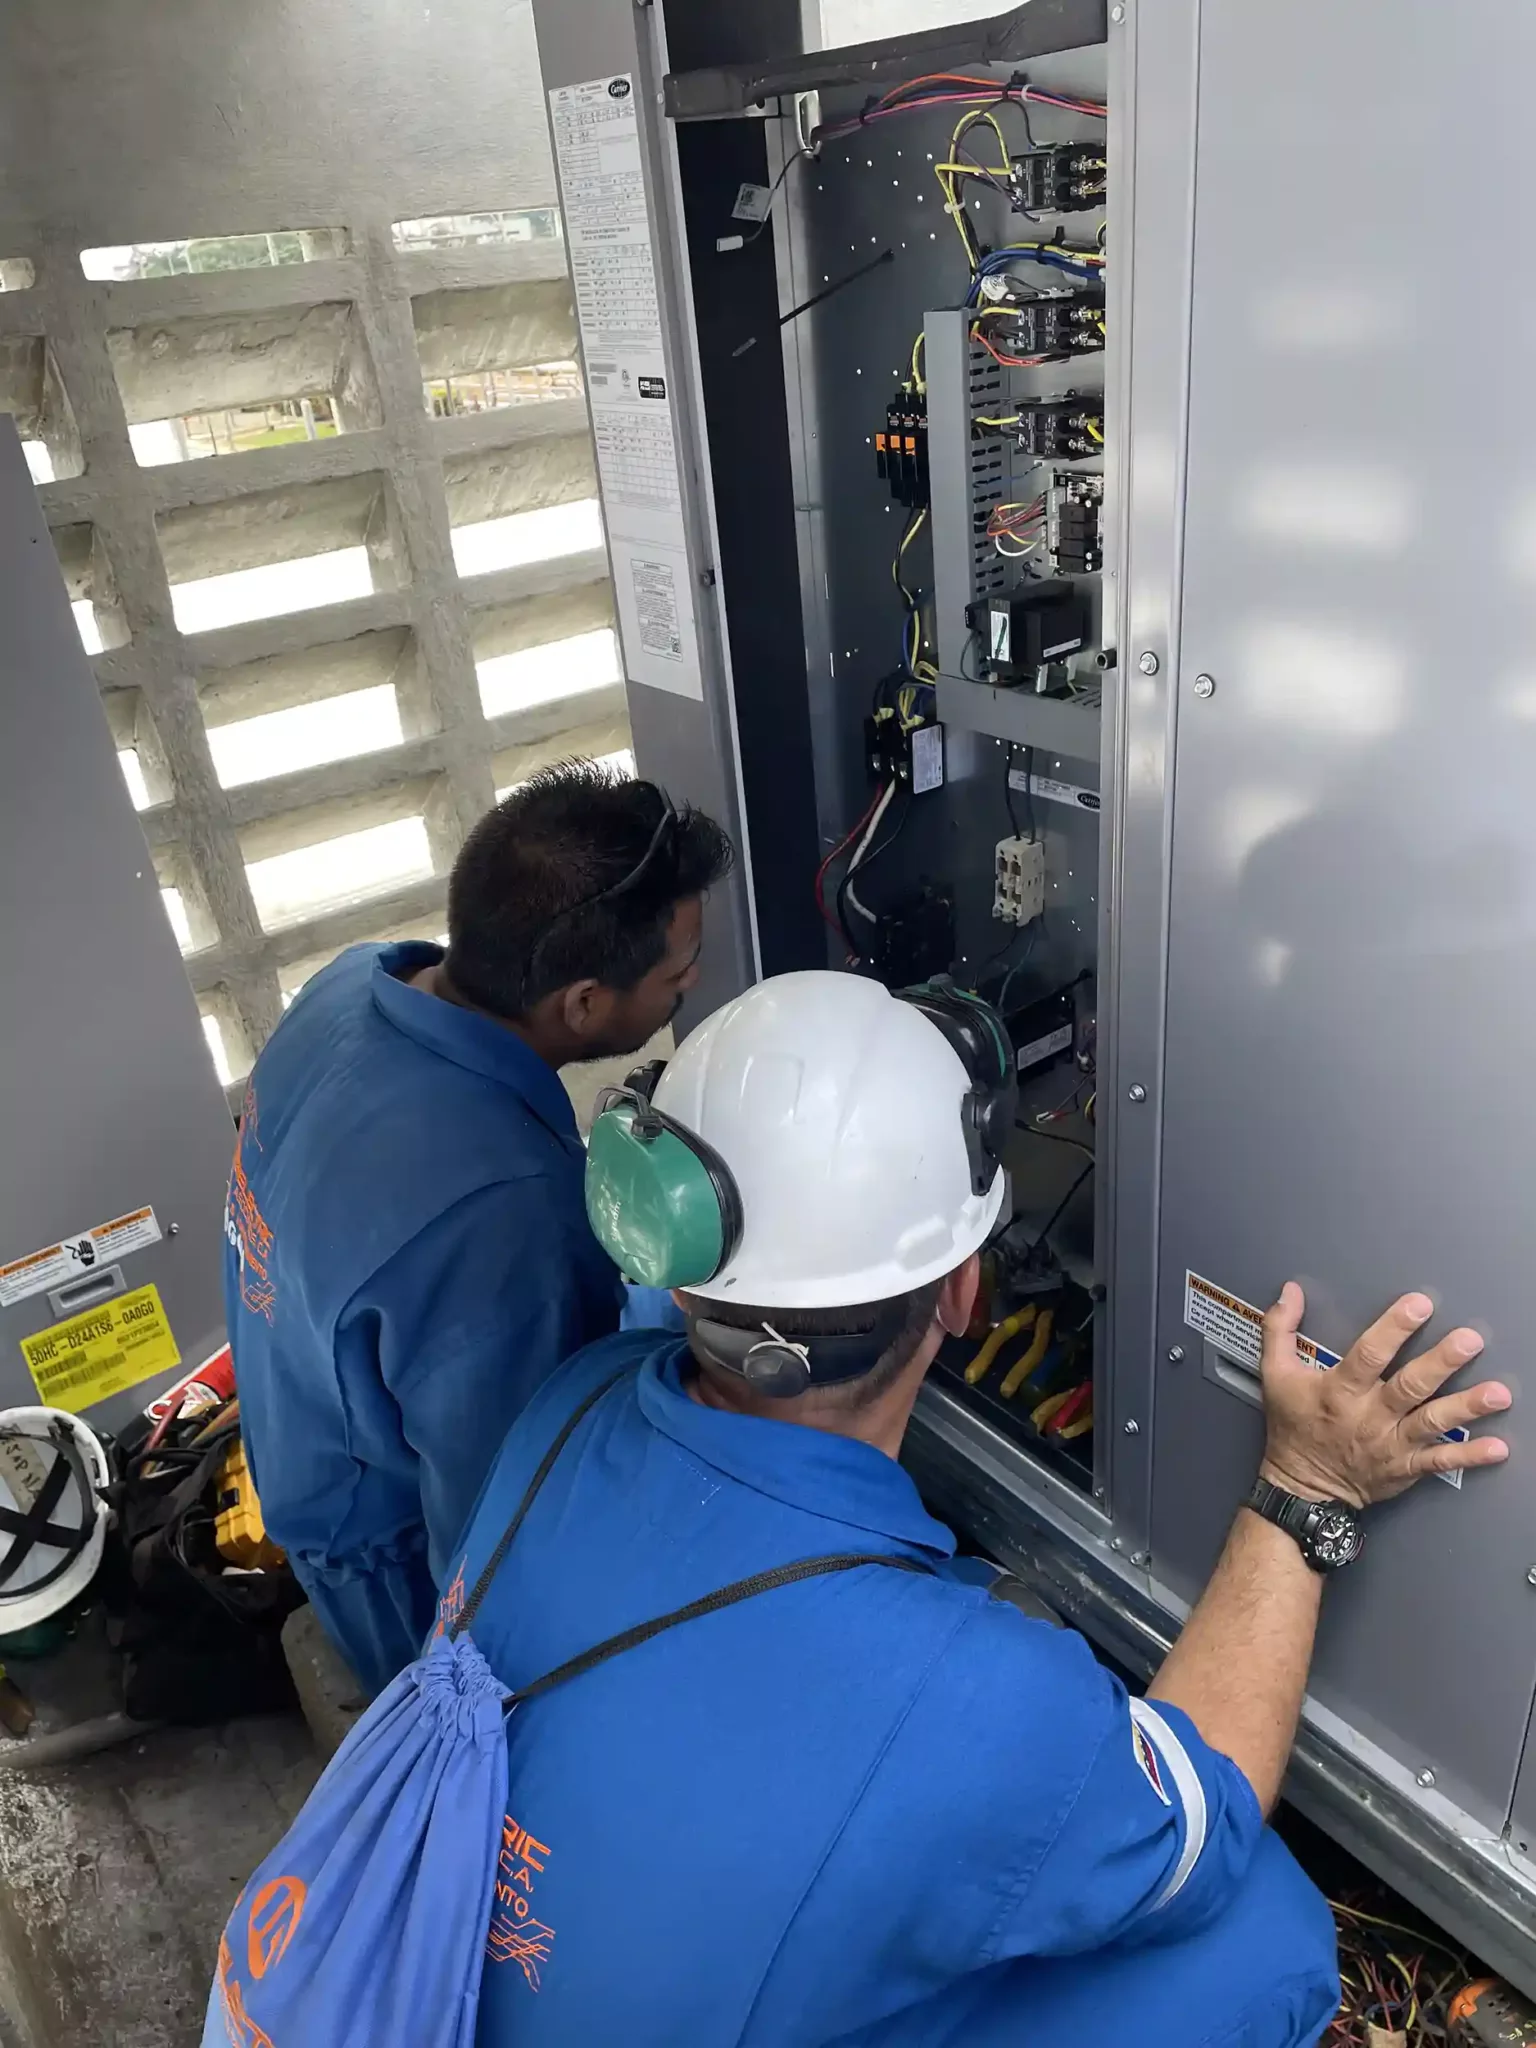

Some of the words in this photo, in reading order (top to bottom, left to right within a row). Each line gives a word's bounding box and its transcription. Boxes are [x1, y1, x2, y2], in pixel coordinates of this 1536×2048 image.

[1190, 1277, 1230, 1307] WARNING
[1191, 1299, 1215, 1317] except
[1192, 1290, 1207, 1304] This
[1207, 1300, 1254, 1331] compartment
